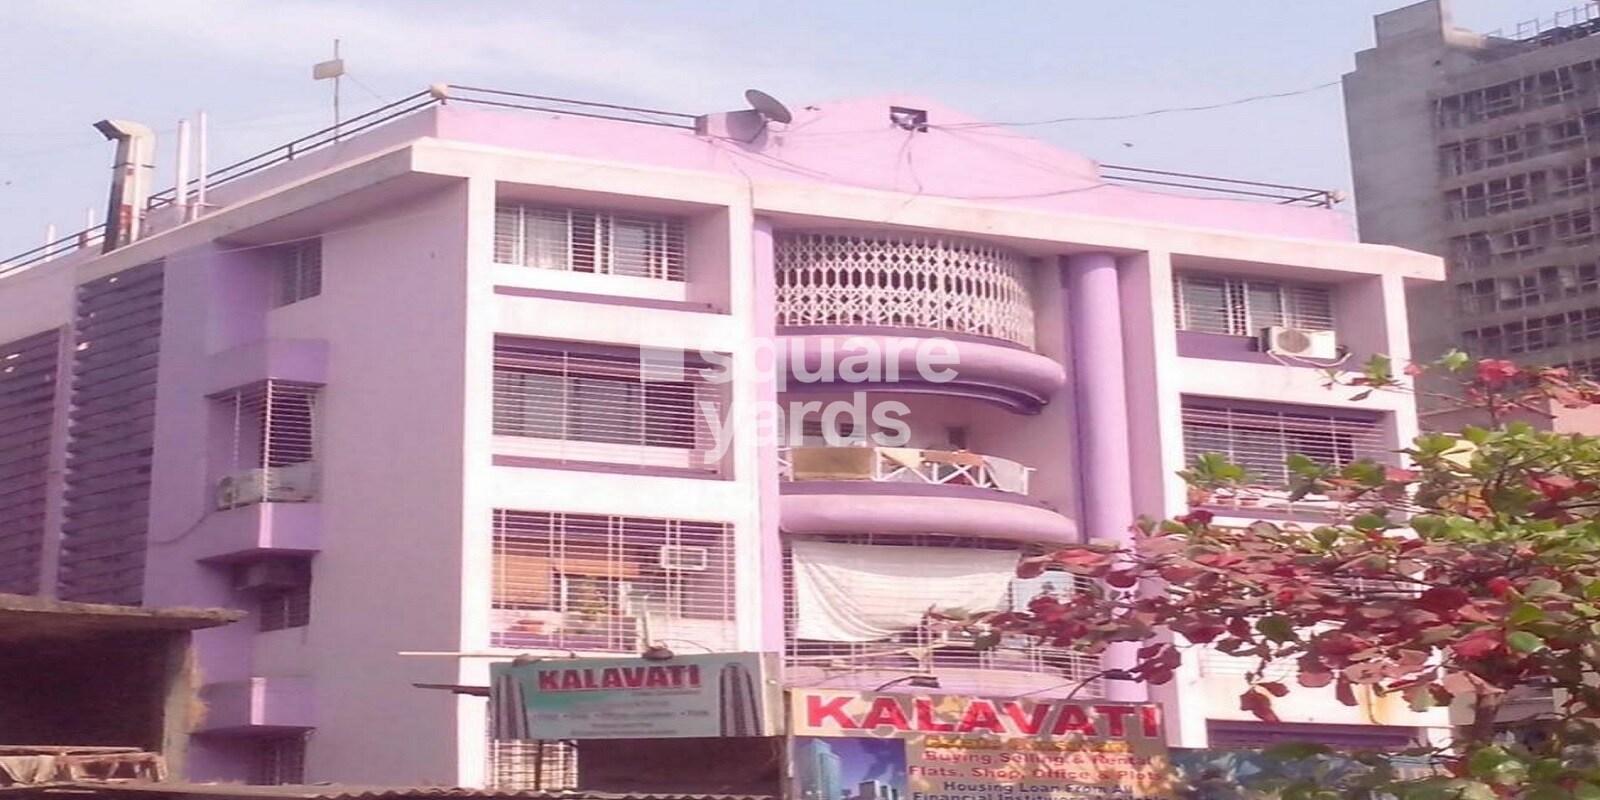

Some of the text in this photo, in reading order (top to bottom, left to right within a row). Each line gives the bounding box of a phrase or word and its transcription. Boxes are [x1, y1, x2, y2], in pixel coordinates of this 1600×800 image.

[539, 665, 701, 690] KALAVATI
[806, 694, 1160, 738] KALAVATI
[944, 782, 1012, 794] Housing
[1019, 782, 1059, 793] Loan
